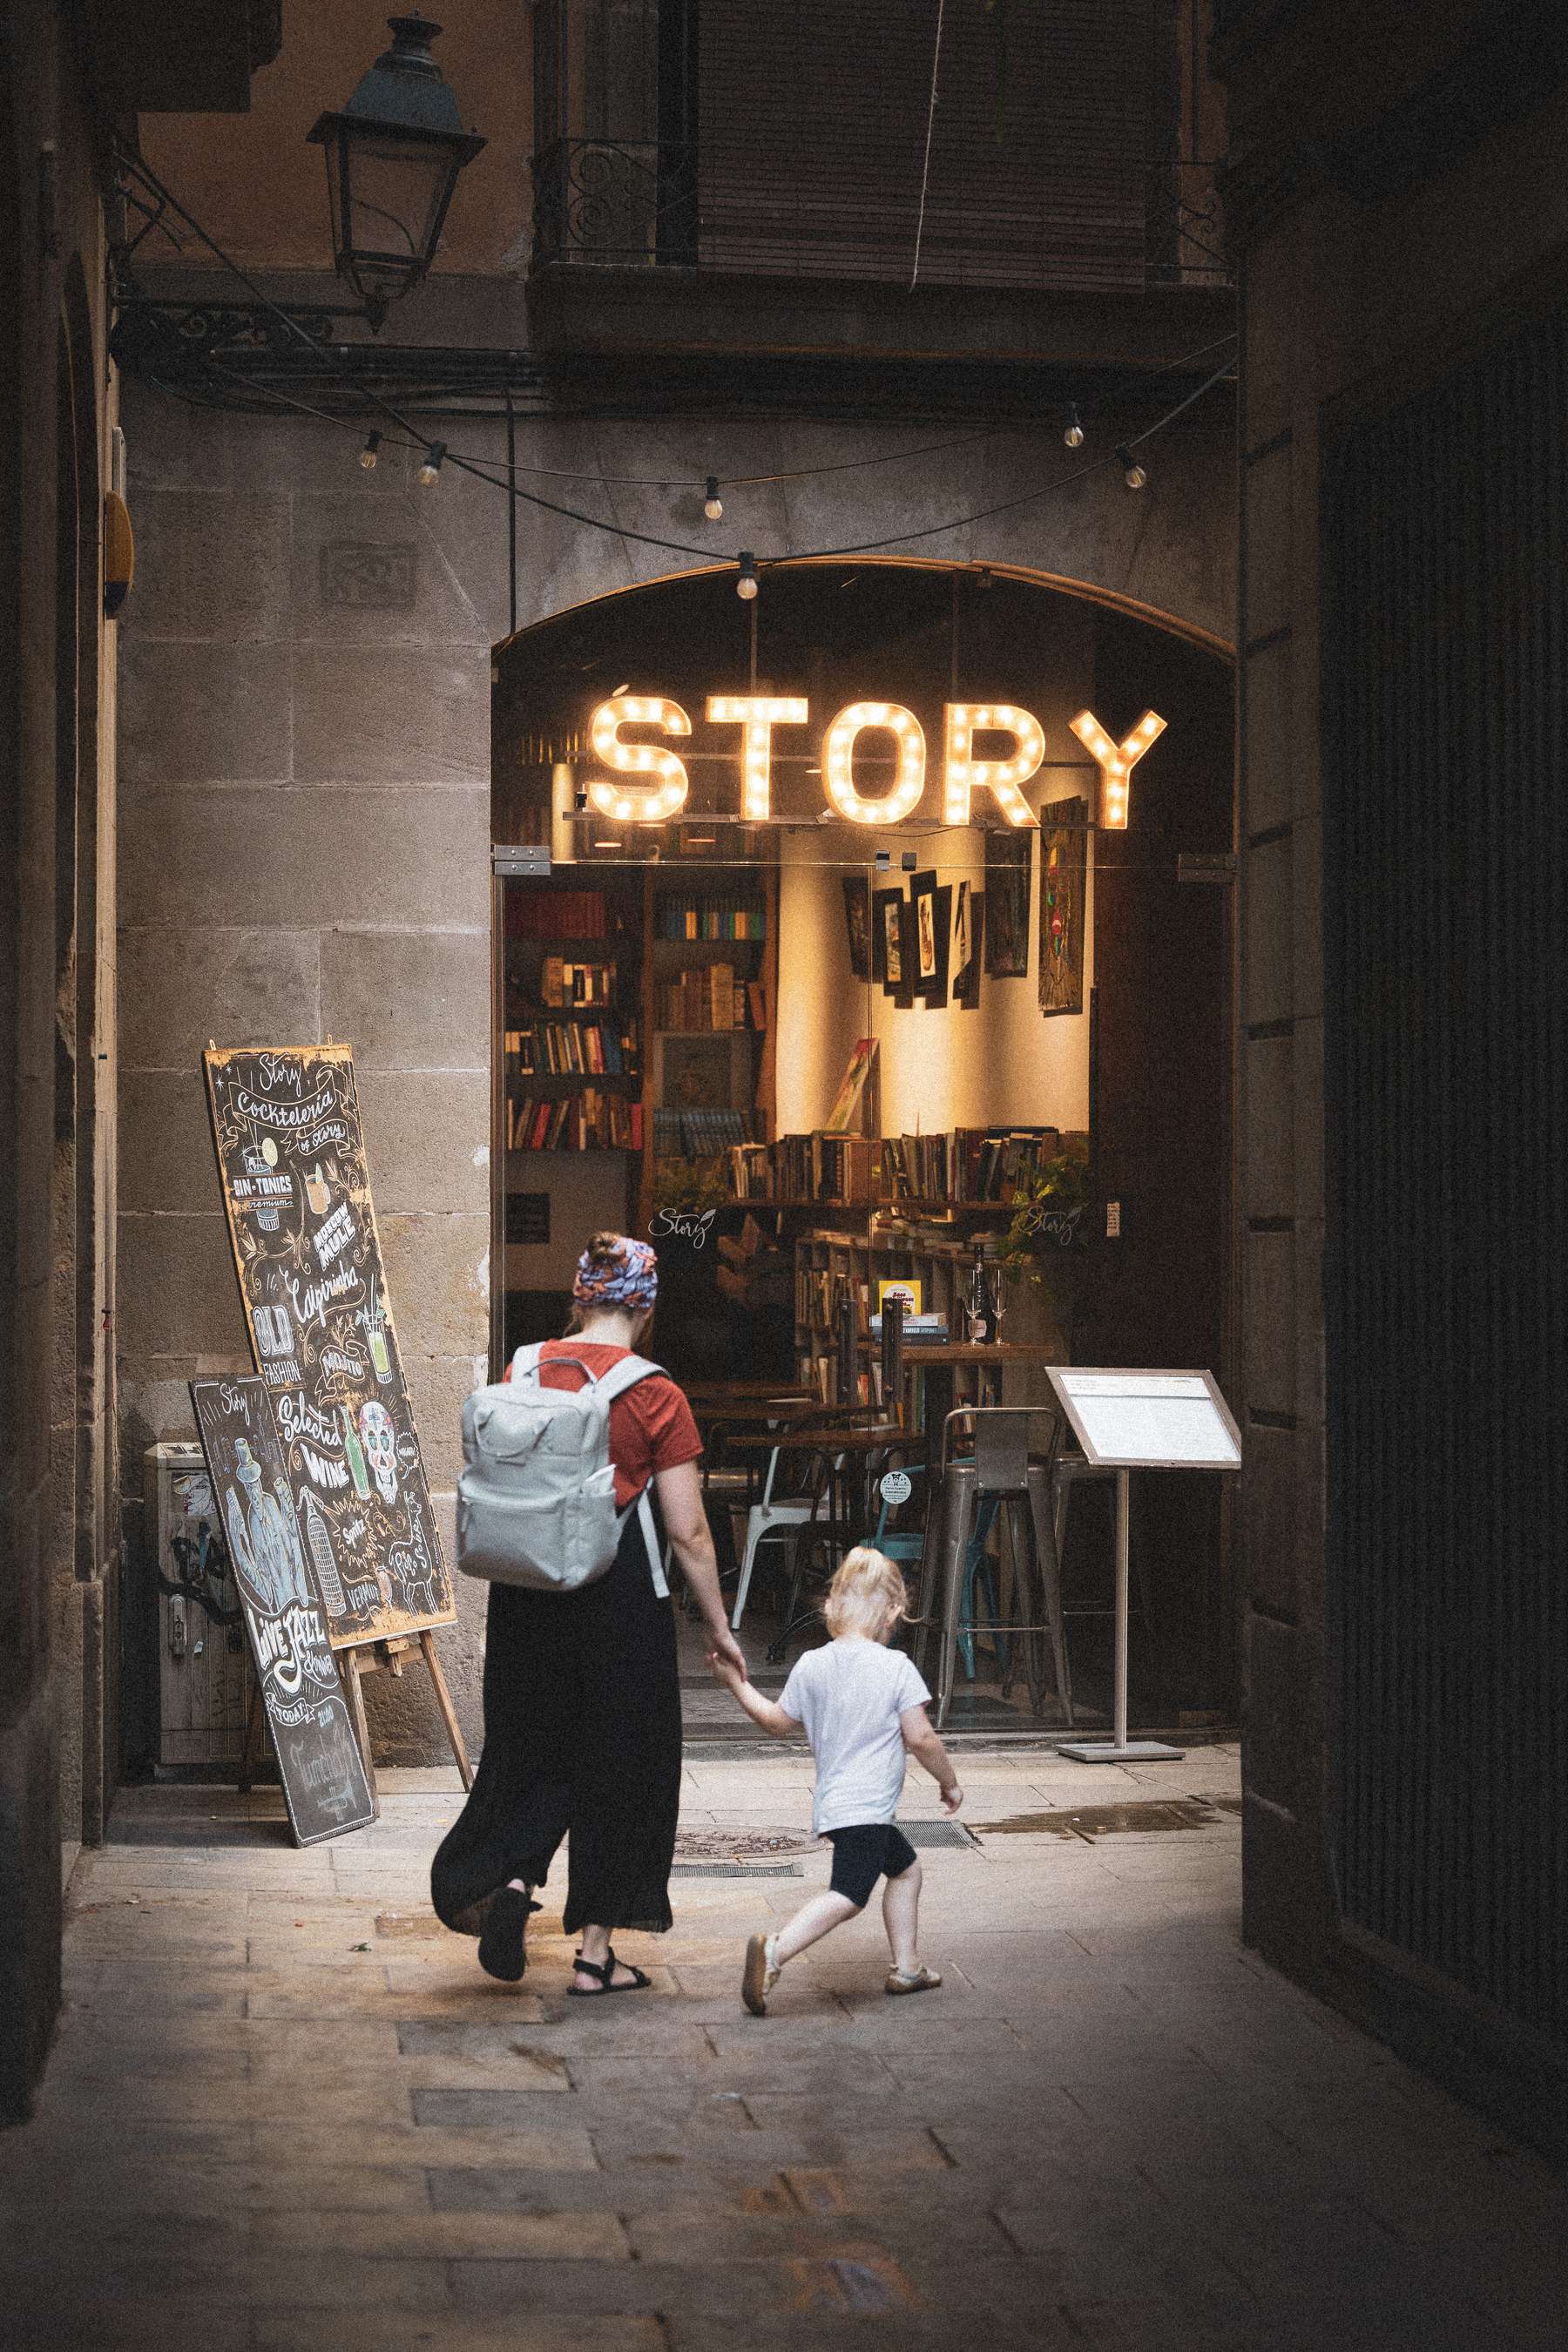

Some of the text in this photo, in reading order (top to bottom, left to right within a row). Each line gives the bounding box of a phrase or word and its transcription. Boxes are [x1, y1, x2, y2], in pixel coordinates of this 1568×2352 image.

[586, 694, 1169, 829] STORY
[259, 1052, 302, 1097] Story
[318, 1214, 356, 1272] MULE
[647, 1207, 717, 1249] Story
[252, 1304, 294, 1356] OLD
[220, 1382, 250, 1426] Story
[278, 1390, 343, 1448] Selected
[300, 1443, 349, 1489] WINE
[274, 1605, 328, 1695] JAZZ
